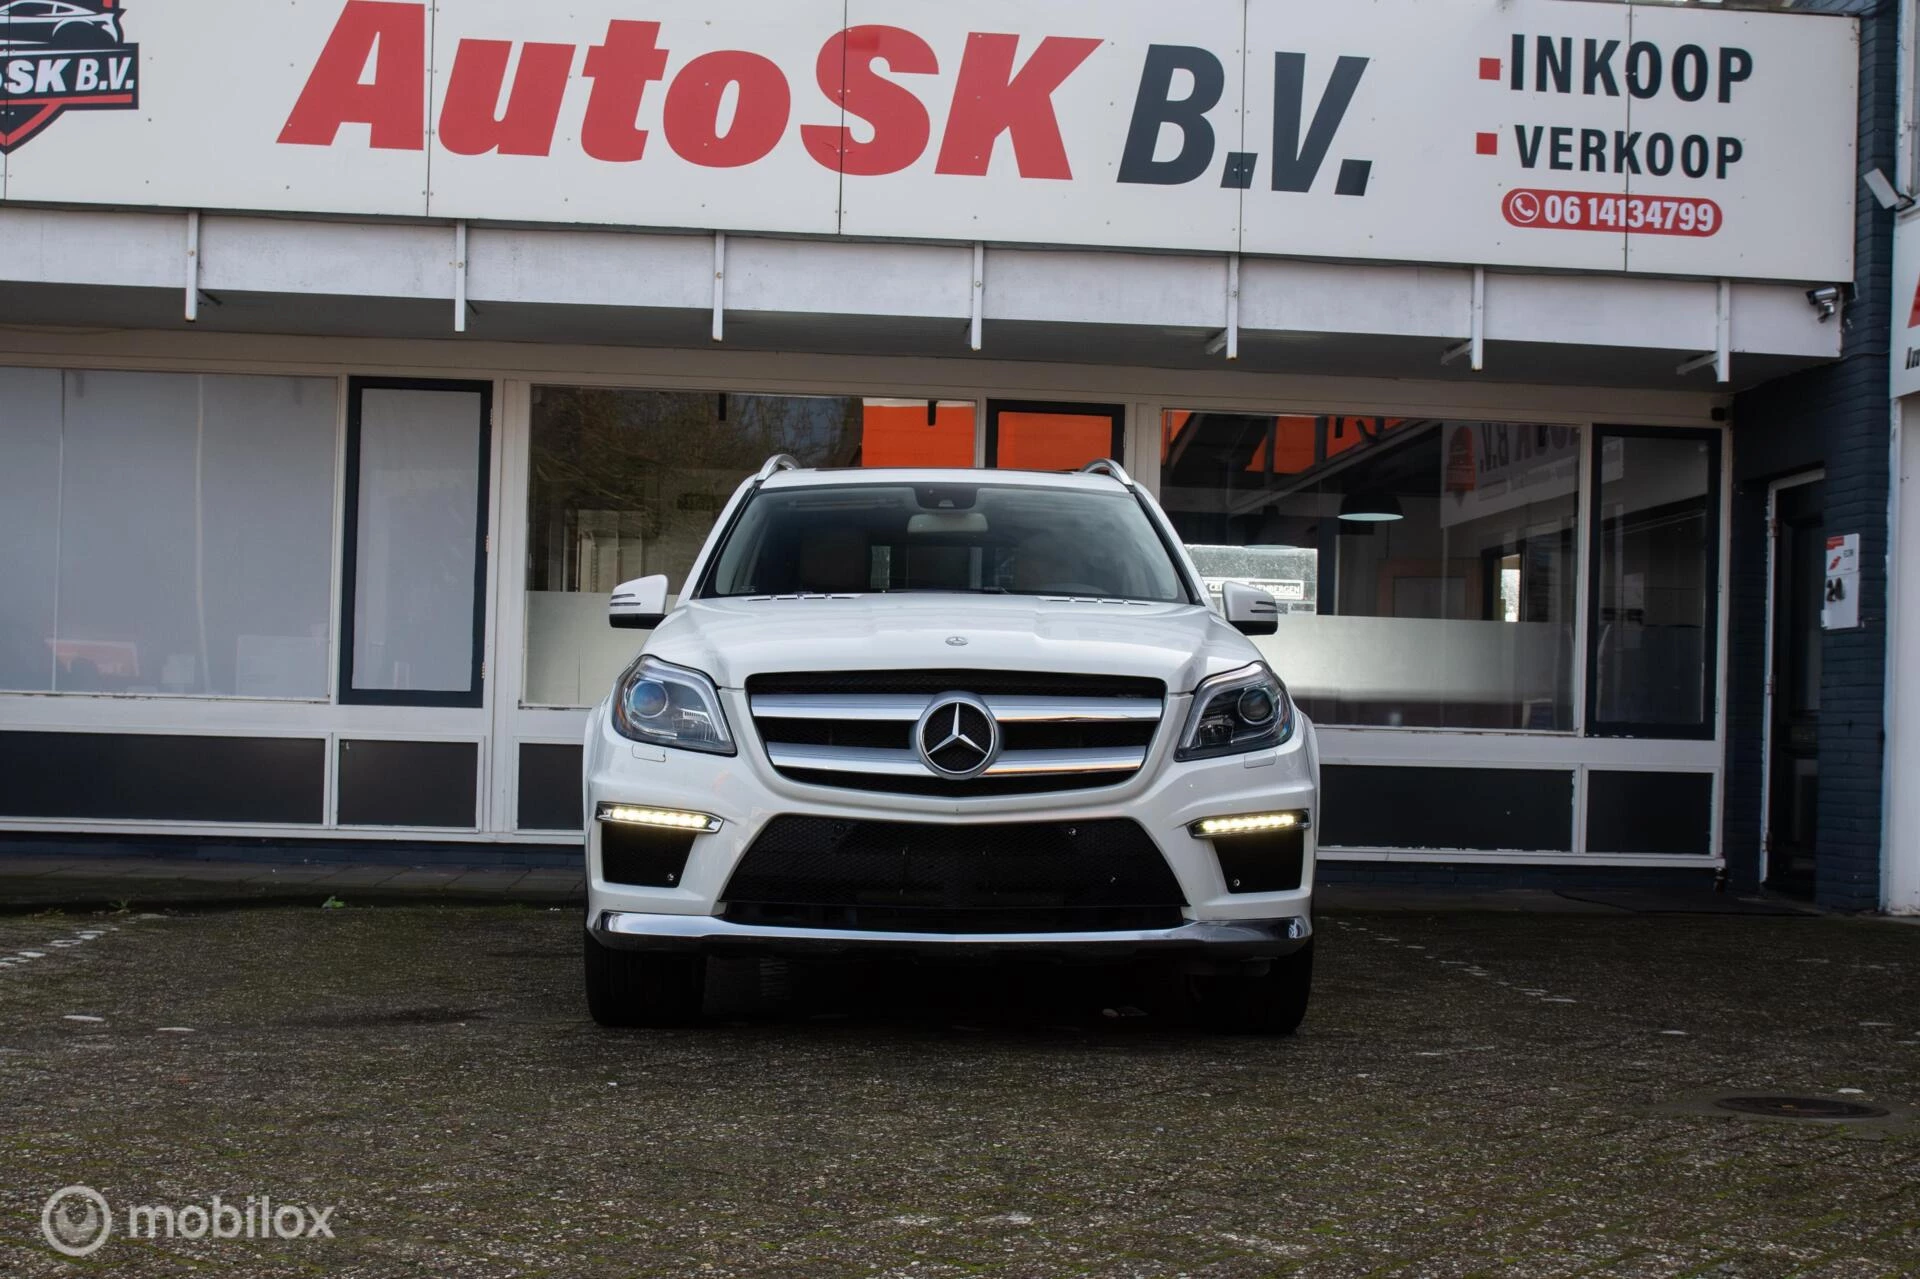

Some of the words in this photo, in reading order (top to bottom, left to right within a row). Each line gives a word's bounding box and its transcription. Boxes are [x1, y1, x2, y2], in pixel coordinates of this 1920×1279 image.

[0, 58, 71, 94] SK
[75, 57, 134, 91] B.V.
[1510, 33, 1753, 103] INKOOP
[277, 0, 1104, 180] AutoSK
[1116, 44, 1373, 197] B.V.
[1514, 124, 1743, 180] VERKOOP
[1544, 194, 1581, 224] 06
[1588, 197, 1715, 232] 14134799
